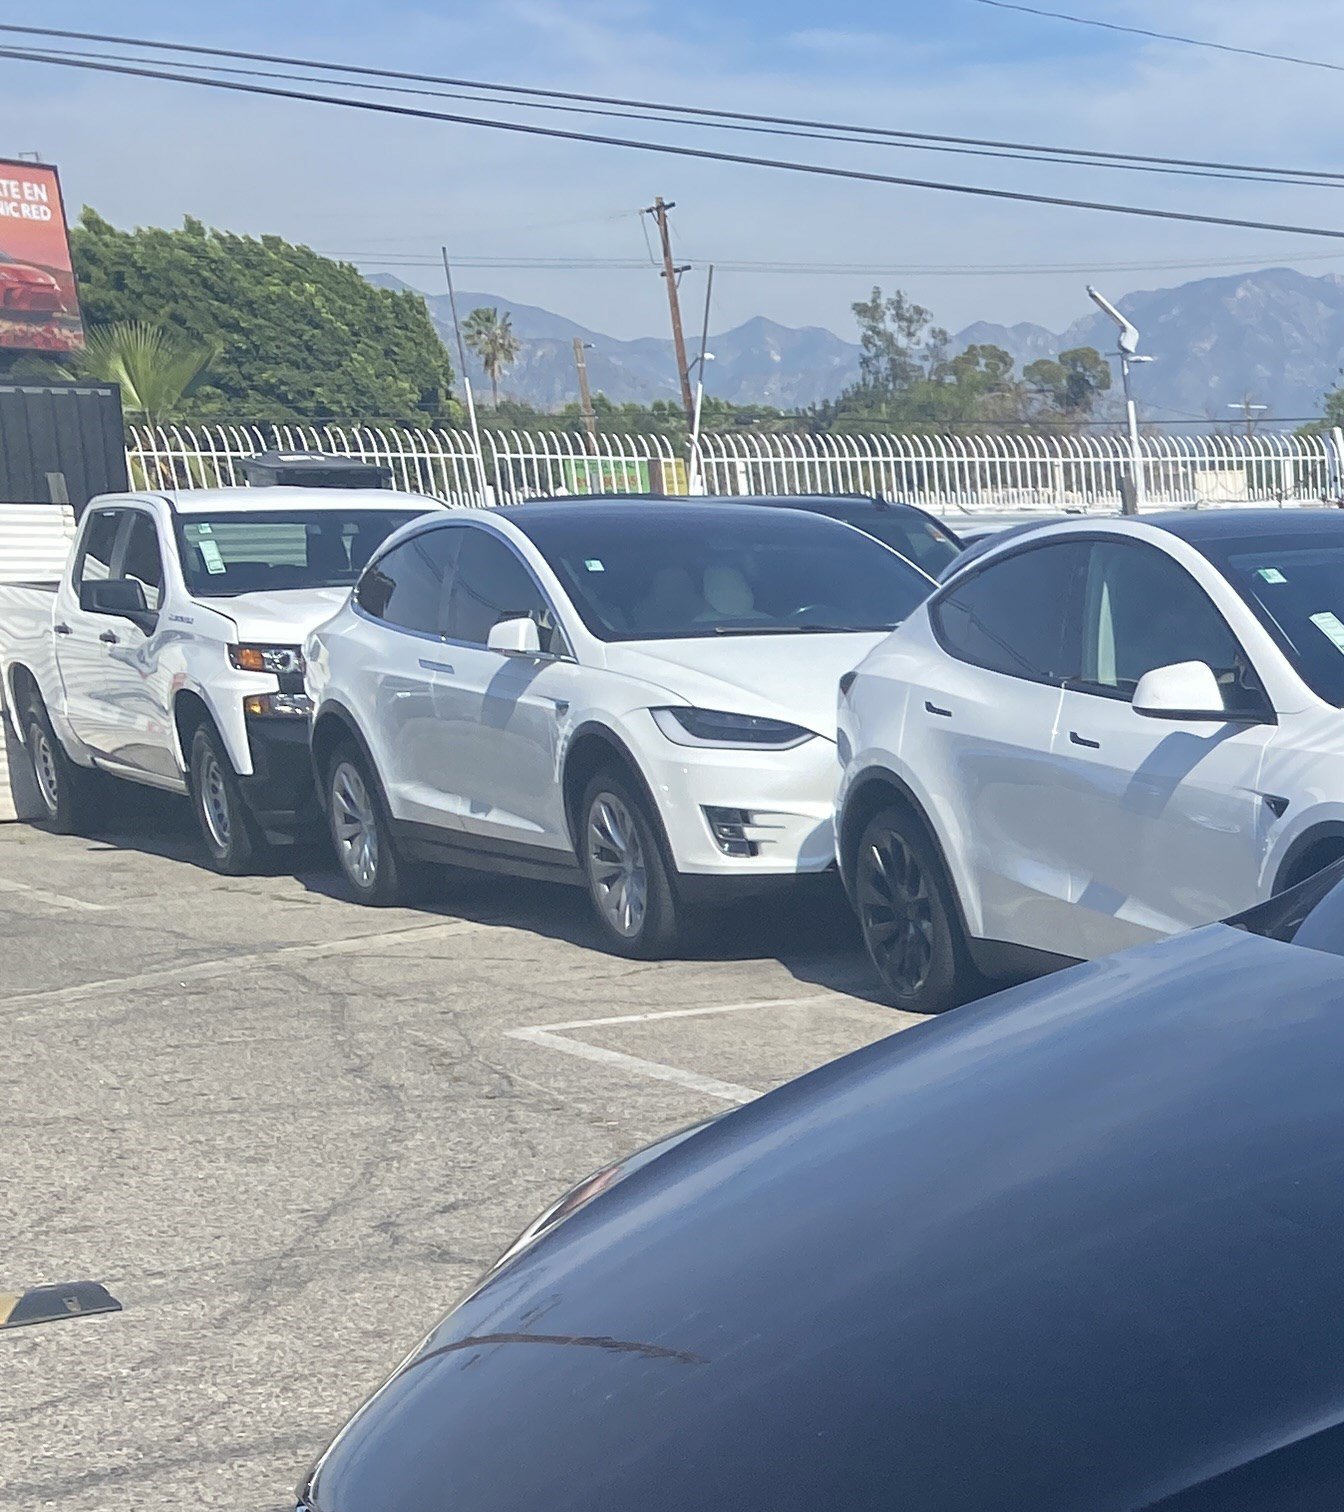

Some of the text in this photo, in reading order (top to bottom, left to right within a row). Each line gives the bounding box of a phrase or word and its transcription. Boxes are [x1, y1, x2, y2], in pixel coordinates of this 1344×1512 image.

[0, 179, 48, 202] TE EN
[20, 203, 52, 221] RED
